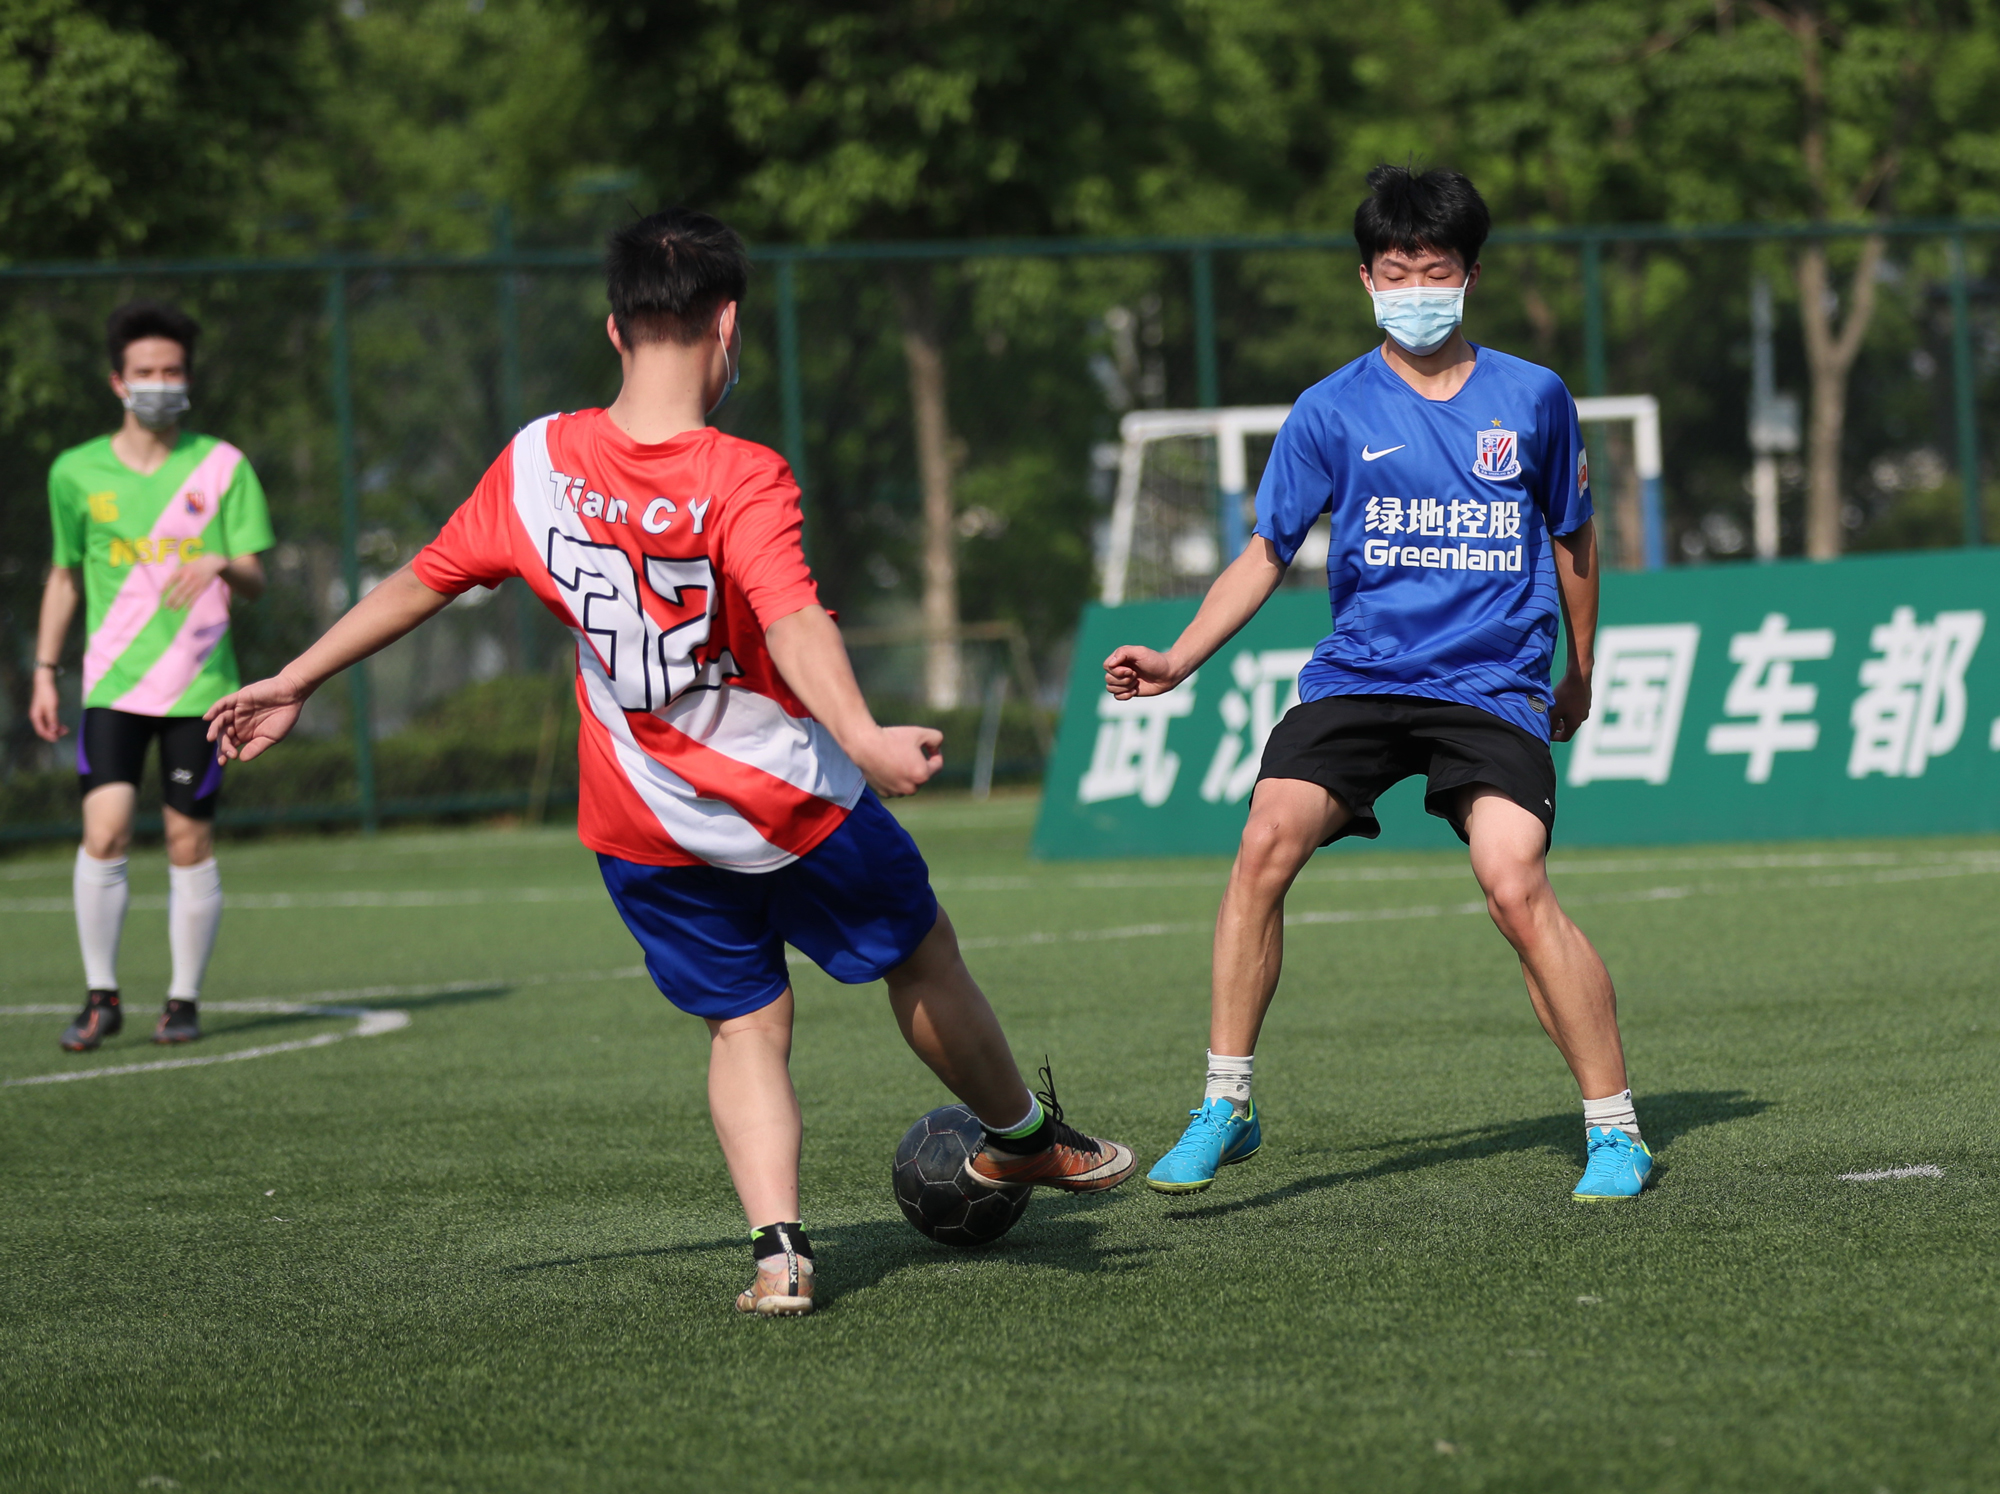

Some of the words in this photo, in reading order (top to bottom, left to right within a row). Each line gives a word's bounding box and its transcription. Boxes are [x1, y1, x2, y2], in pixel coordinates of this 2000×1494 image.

[550, 470, 629, 525] Tian
[641, 497, 677, 534] C
[688, 495, 712, 534] Y
[1364, 496, 1522, 539] 绿地控股
[109, 536, 204, 567] NSFC
[1364, 539, 1522, 572] Greenland
